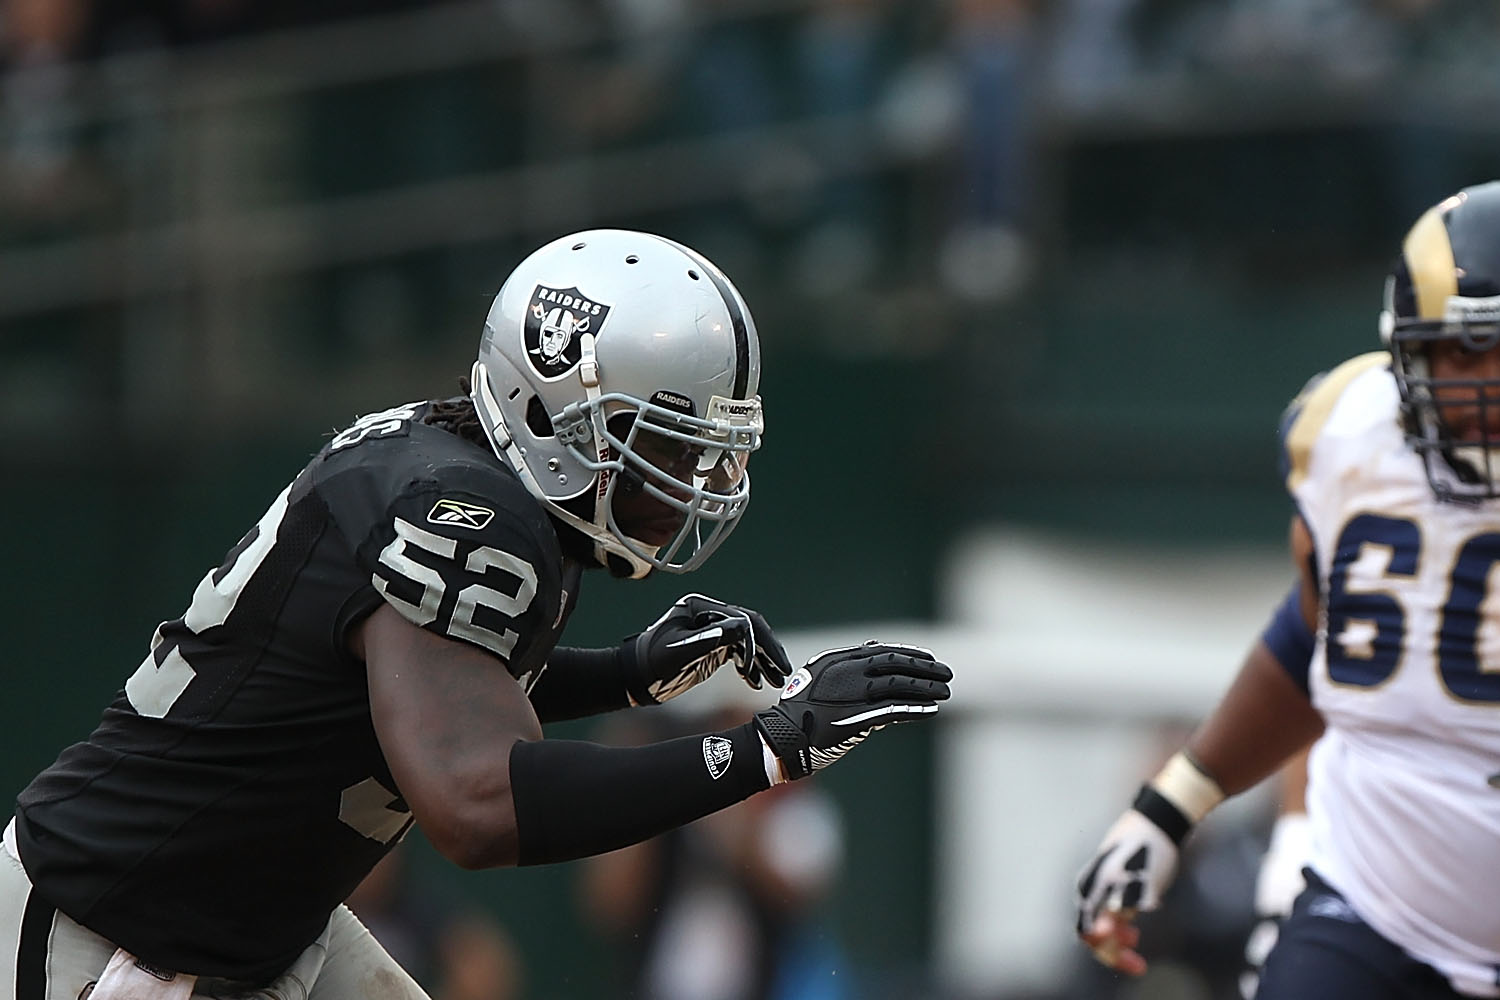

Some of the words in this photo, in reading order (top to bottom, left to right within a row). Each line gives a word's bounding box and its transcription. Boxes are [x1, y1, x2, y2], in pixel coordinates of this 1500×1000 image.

[538, 288, 602, 316] RAIDERS
[656, 391, 691, 408] RAIDERS
[372, 516, 539, 661] 52
